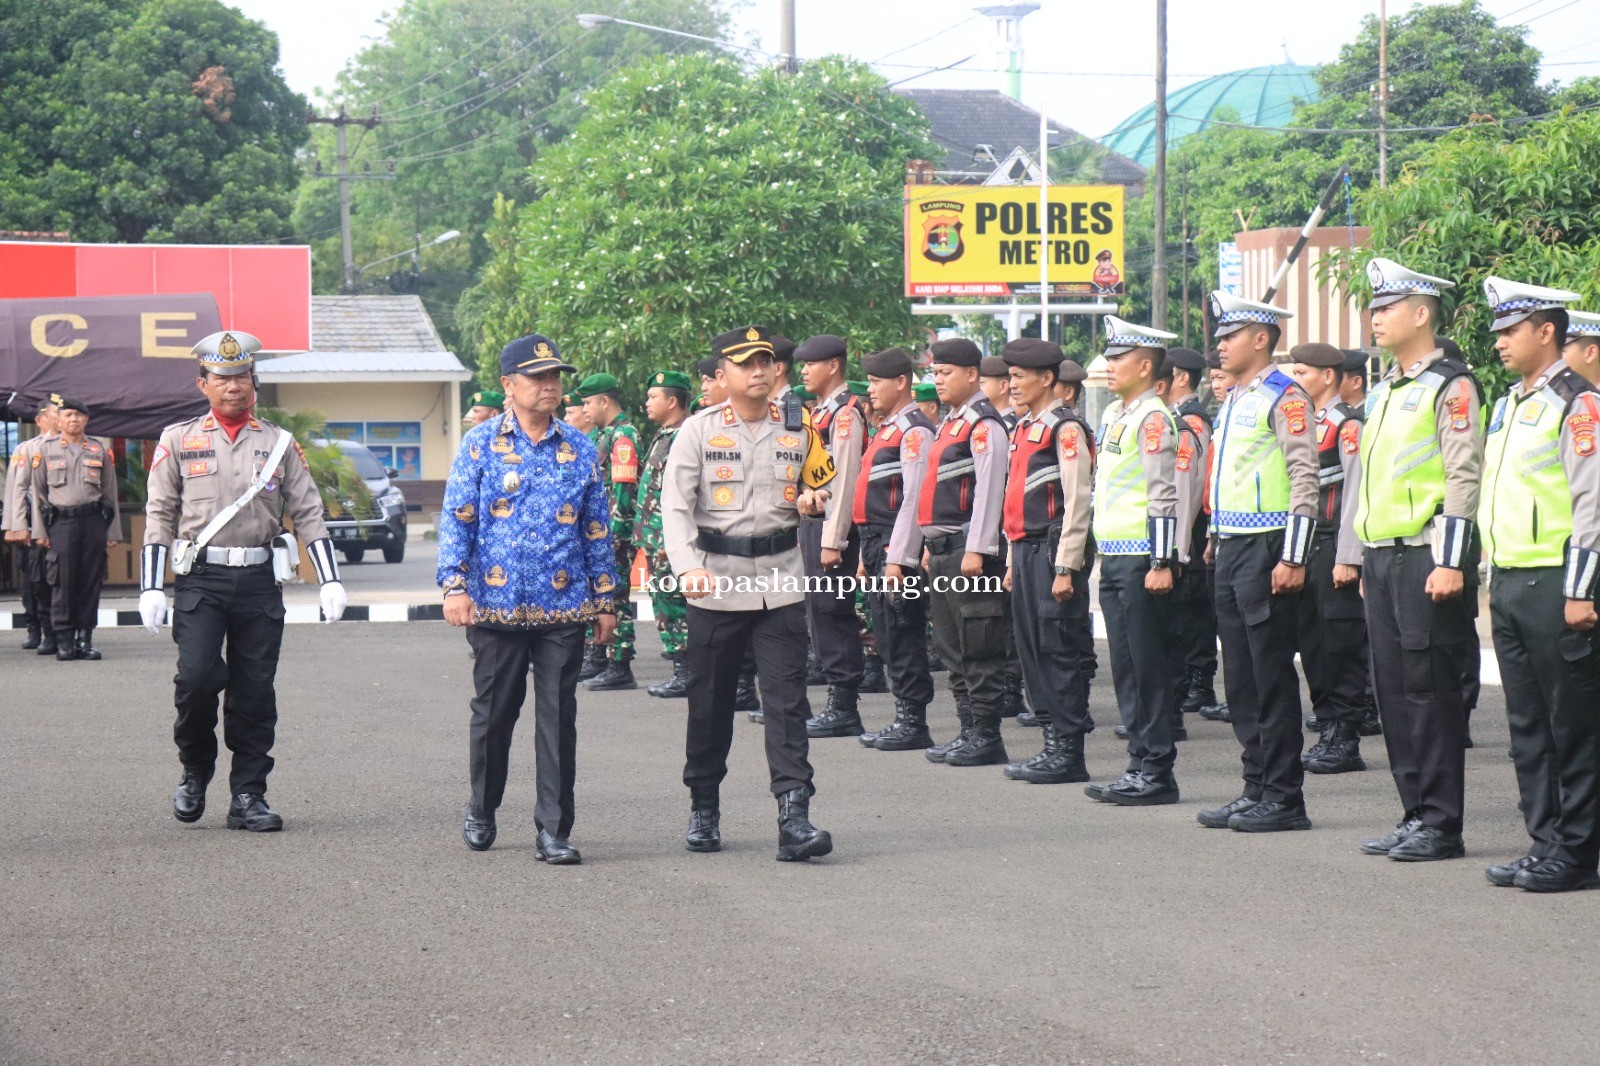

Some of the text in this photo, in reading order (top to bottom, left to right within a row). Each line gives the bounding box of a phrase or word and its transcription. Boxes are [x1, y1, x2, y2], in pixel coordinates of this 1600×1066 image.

[921, 201, 962, 212] LAMPUNG
[975, 201, 1113, 235] POLRES
[775, 451, 803, 463] POLRI
[811, 465, 828, 483] KA
